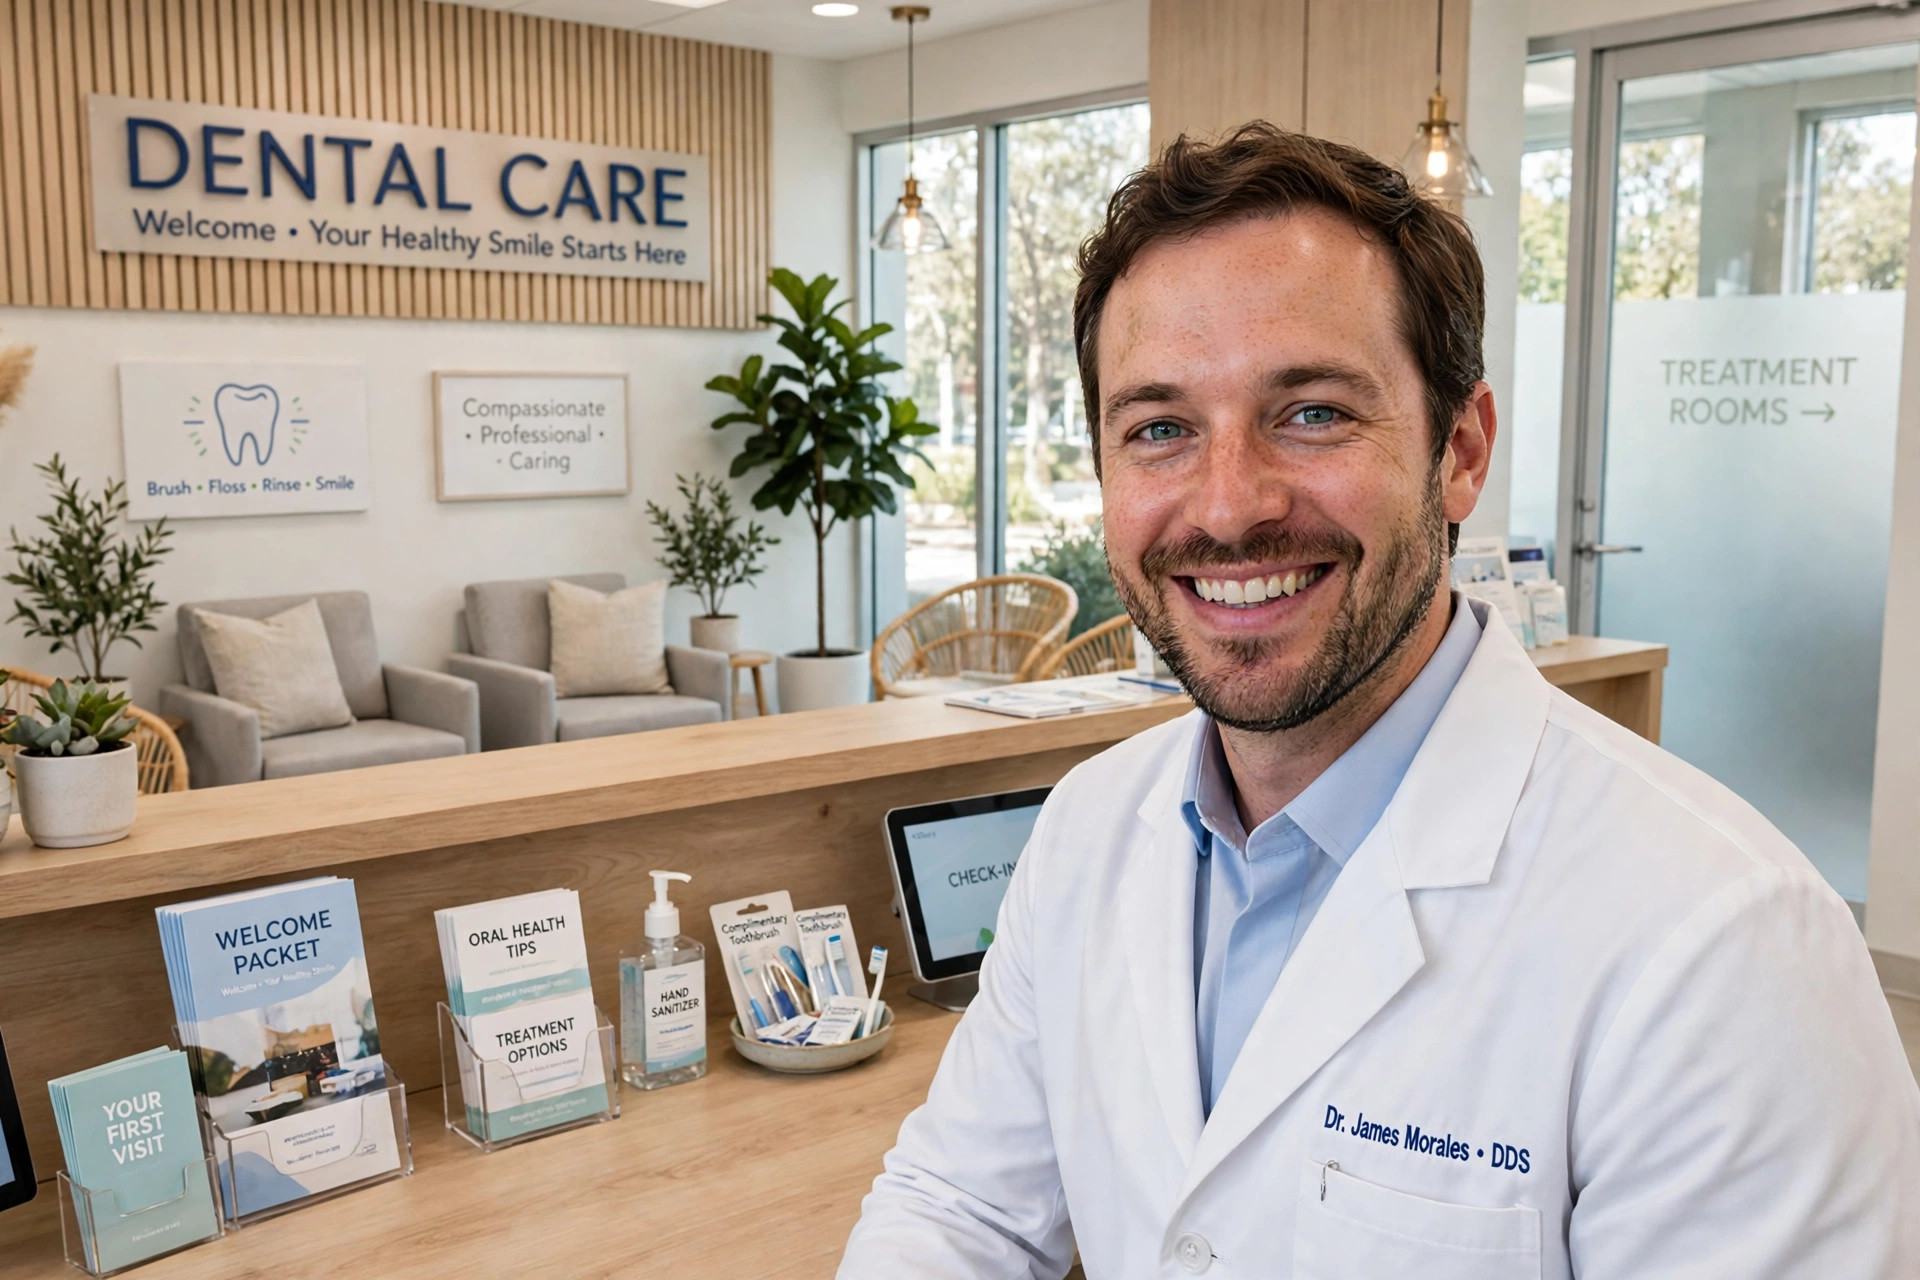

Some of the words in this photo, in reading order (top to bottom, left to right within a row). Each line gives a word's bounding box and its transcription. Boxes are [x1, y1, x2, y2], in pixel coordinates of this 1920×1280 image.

[126, 117, 472, 211] DENTAL
[500, 153, 688, 228] CARE
[133, 208, 275, 241] Welcome
[309, 219, 371, 247] Your
[381, 225, 480, 259] Healthy
[488, 230, 554, 257] Smile
[562, 235, 627, 262] Starts
[635, 241, 687, 266] Here
[1660, 357, 1858, 386] TREATMENT
[463, 397, 606, 421] Compassionate
[1670, 397, 1788, 426] ROOMS
[481, 423, 592, 444] Professional
[509, 451, 571, 474] Caring
[147, 480, 192, 496] Brush
[208, 479, 246, 494] Floss
[262, 477, 301, 491] Rinse
[315, 475, 354, 490] Smile
[948, 861, 1018, 887] CHECK-IN
[215, 909, 332, 950] WELCOME
[468, 928, 508, 946] ORAL
[512, 915, 566, 938] HEALTH
[729, 928, 780, 945] Toothbrush
[233, 938, 320, 975] PACKET
[506, 941, 537, 958] TIPS
[651, 998, 700, 1018] SANITIZER
[661, 987, 689, 1002] HAND
[496, 1017, 575, 1047] TREATMENT
[508, 1038, 568, 1063] OPTIONS
[102, 1091, 162, 1121] YOUR
[106, 1111, 164, 1144] FIRST
[1324, 1104, 1345, 1132] Dr.
[1351, 1112, 1399, 1146] James
[1404, 1124, 1470, 1161] Morales
[1491, 1142, 1531, 1174] DDS
[112, 1133, 165, 1165] VISIT
